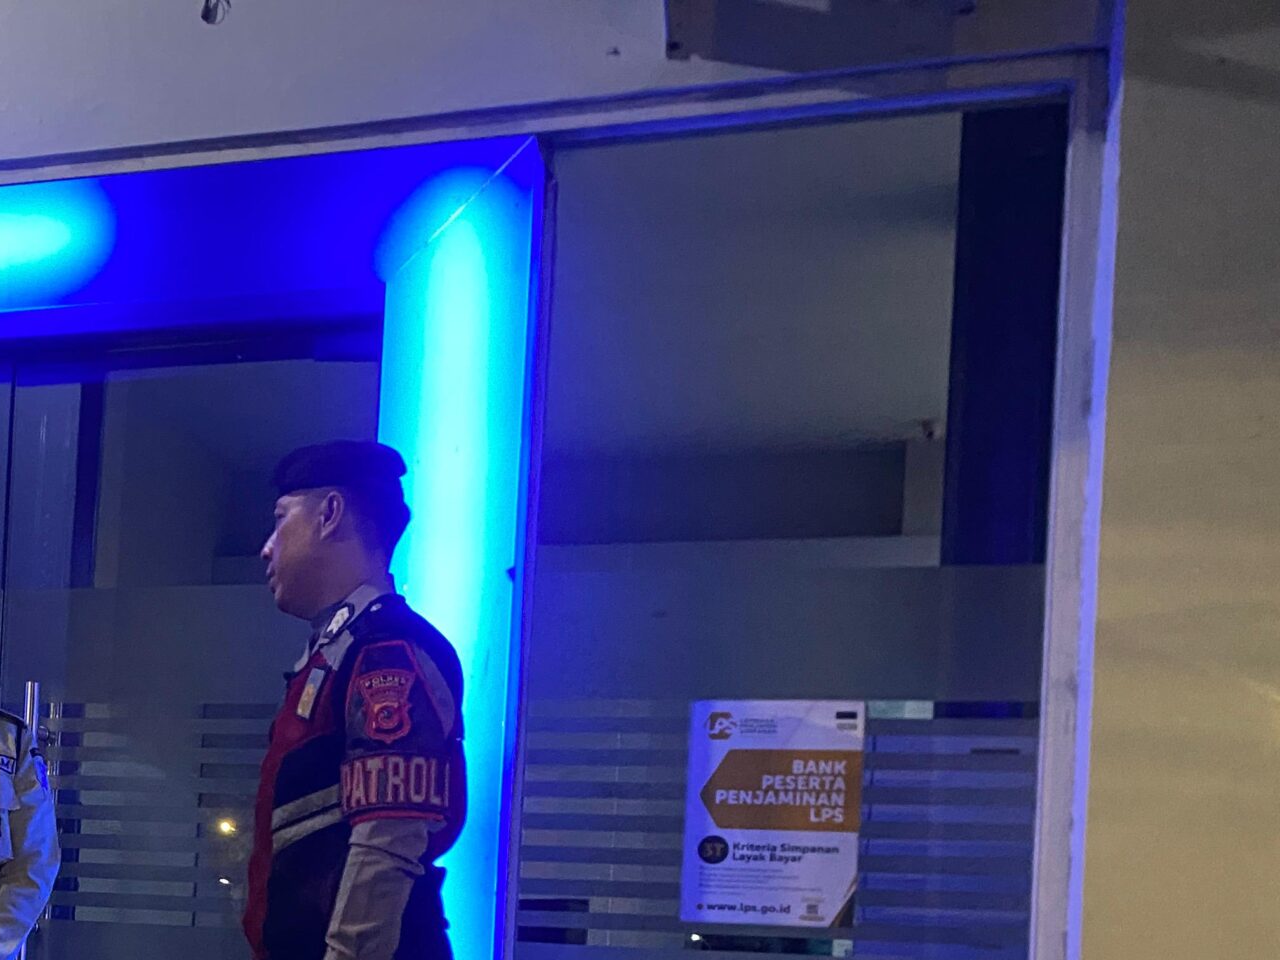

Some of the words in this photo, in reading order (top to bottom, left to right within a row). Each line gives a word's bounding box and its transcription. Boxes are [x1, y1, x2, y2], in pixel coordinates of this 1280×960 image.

[792, 760, 848, 775] BANK
[341, 756, 449, 811] PATROLI
[762, 775, 846, 791] PESERTA
[715, 789, 845, 806] PENJAMINAN
[810, 808, 844, 823] LPS
[733, 842, 777, 852] Kriteria
[780, 843, 839, 854] Simpanan
[733, 853, 765, 863] Layak
[769, 854, 802, 864] Bayar
[707, 903, 791, 915] www.lps.go.id
